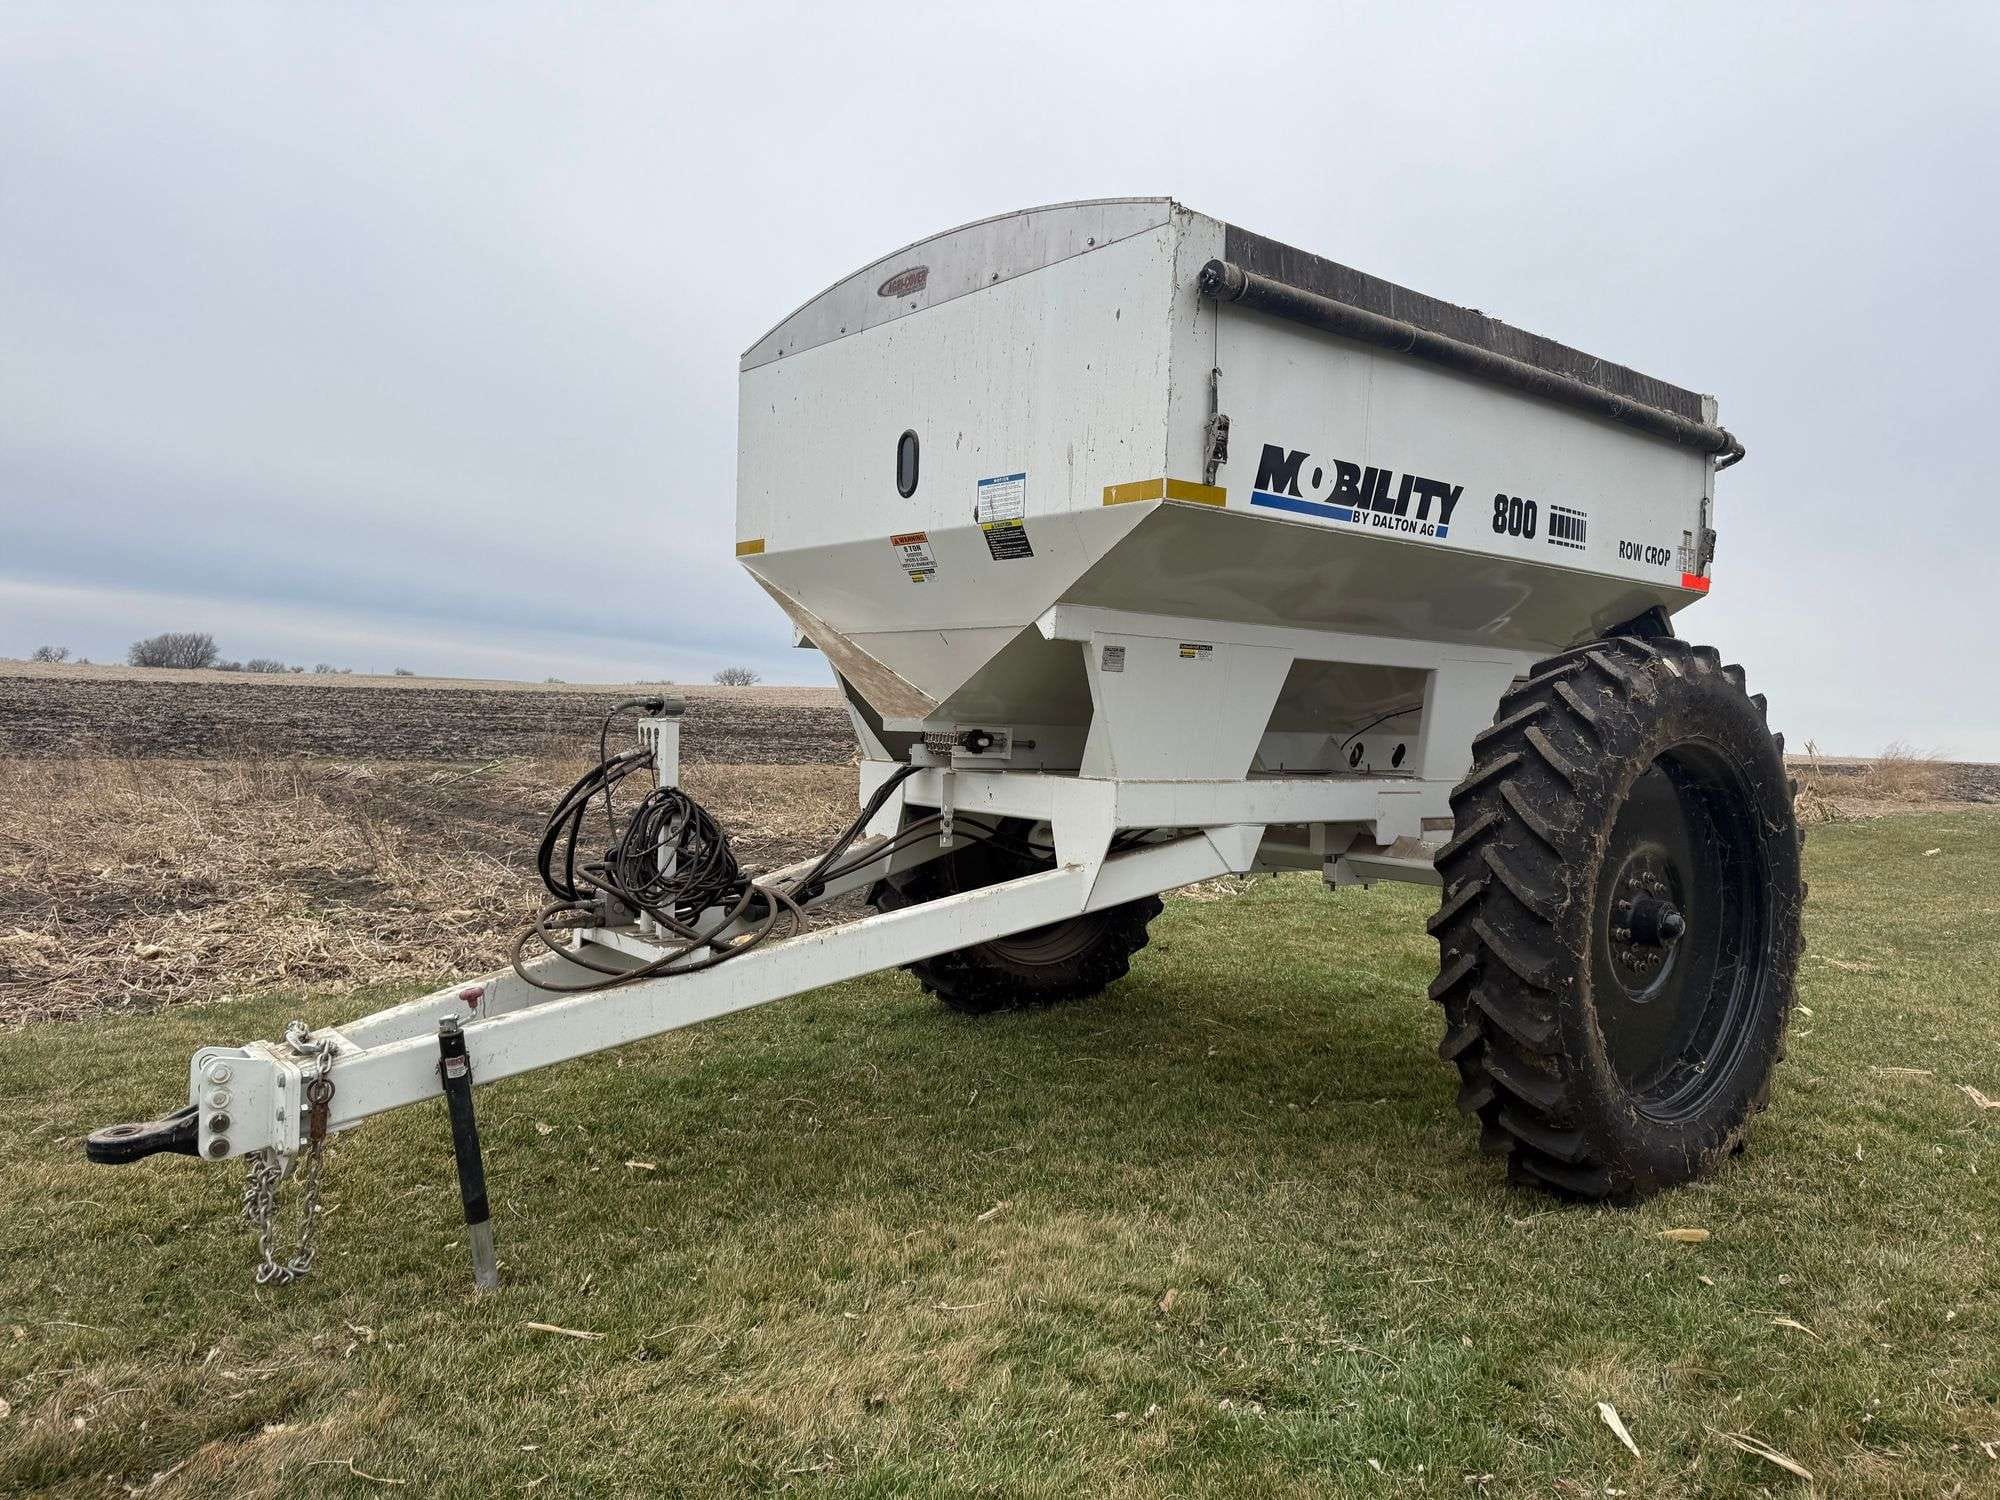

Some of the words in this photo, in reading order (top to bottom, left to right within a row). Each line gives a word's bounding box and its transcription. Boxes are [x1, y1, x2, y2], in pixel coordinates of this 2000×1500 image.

[1254, 443, 1465, 525] MOBILITY
[1352, 510, 1370, 525] BY
[1372, 514, 1418, 533] DALTON
[1419, 523, 1435, 536] AG
[1492, 493, 1538, 540] 800
[1618, 540, 1643, 562] ROW
[1645, 545, 1671, 567] CROP
